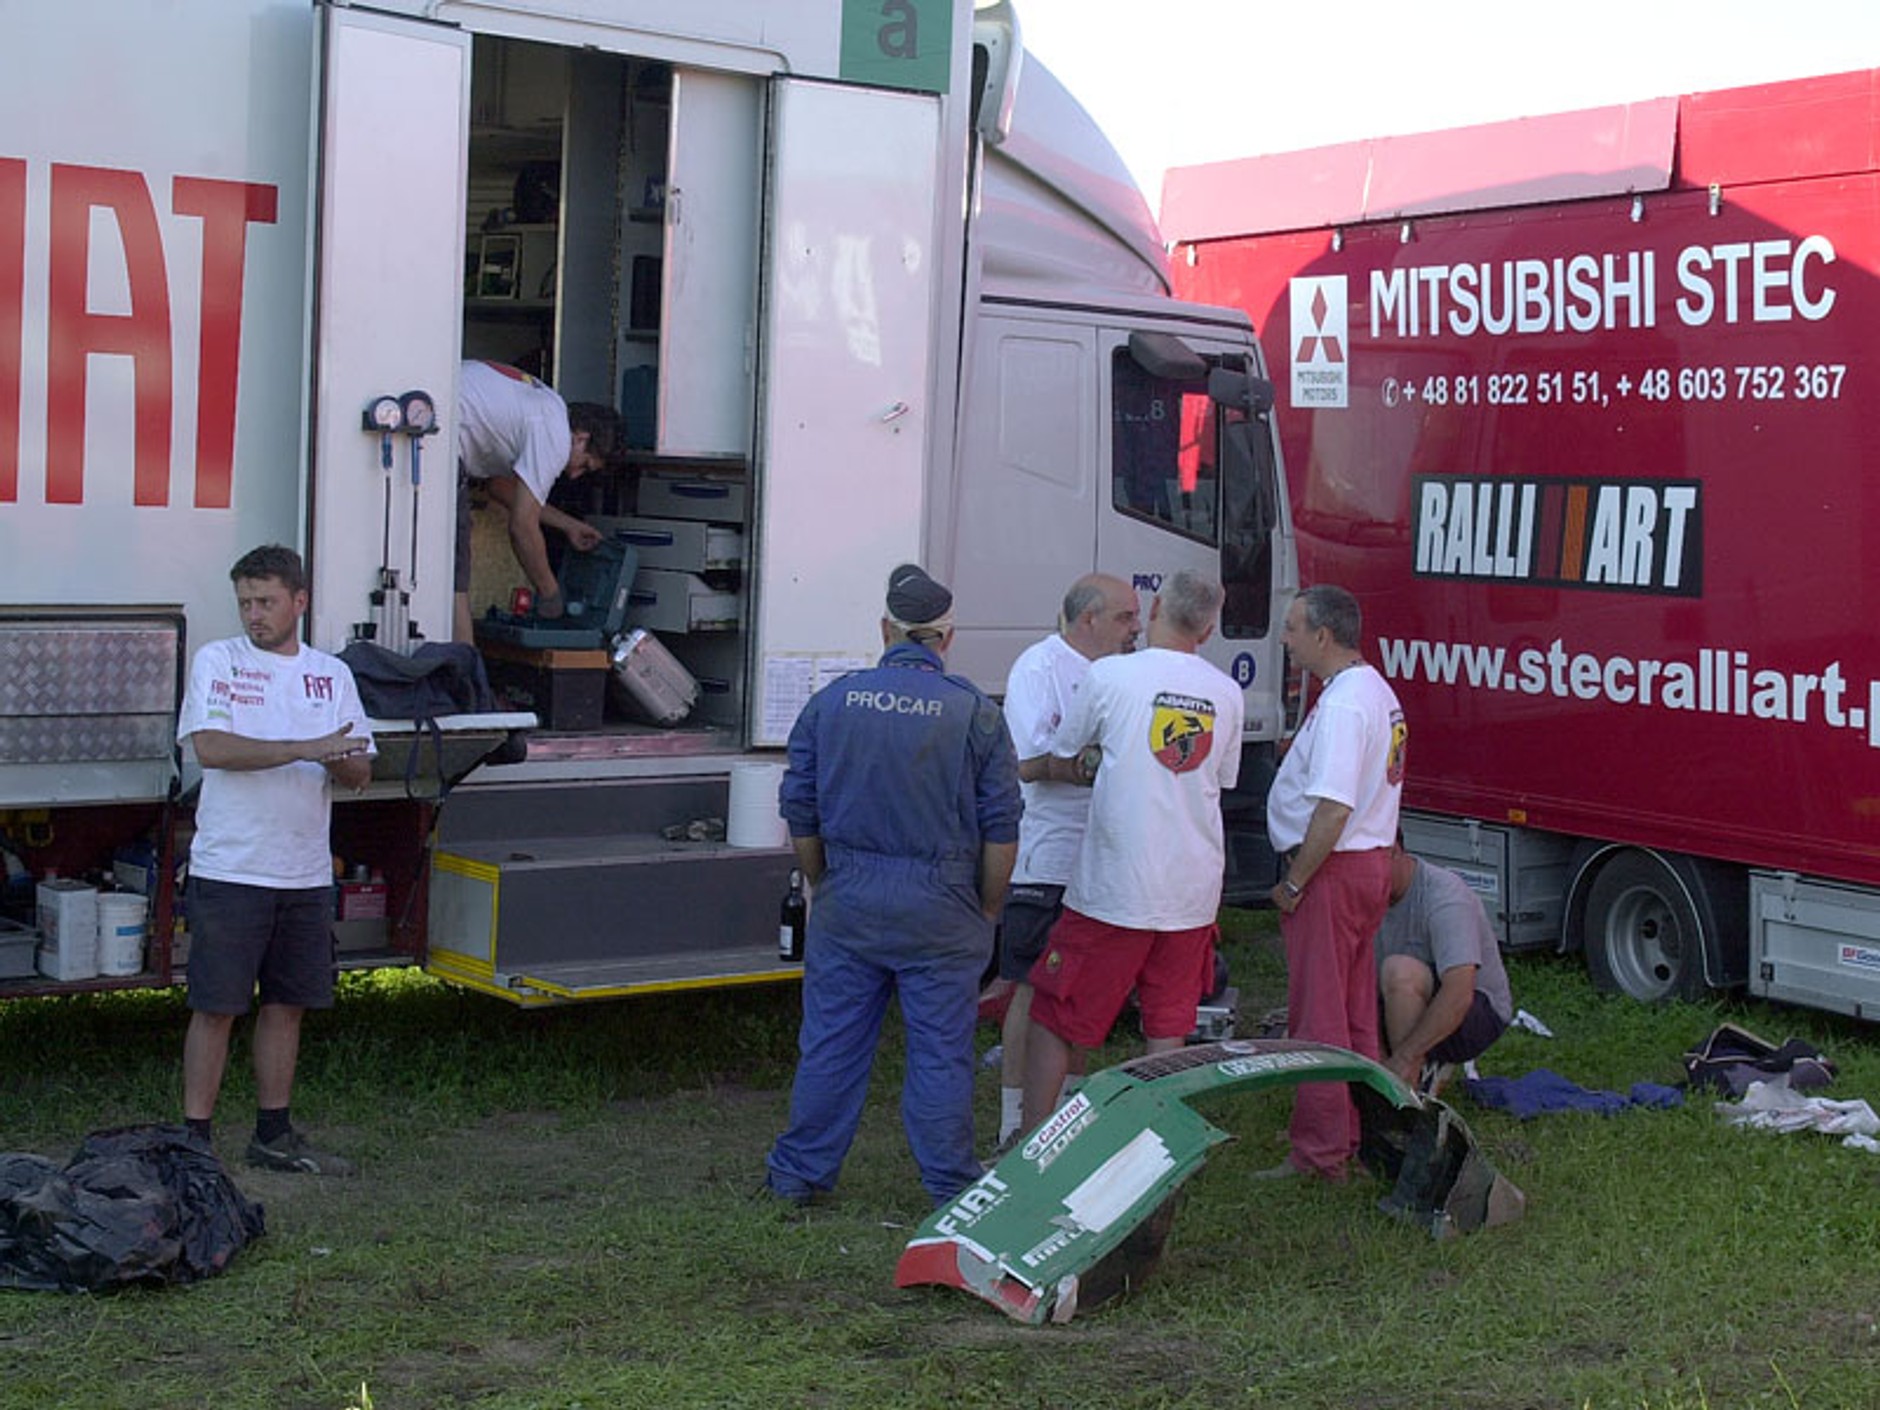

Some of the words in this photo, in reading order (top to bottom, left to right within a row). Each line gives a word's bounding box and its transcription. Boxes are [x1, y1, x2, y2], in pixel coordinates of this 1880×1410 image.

[877, 0, 919, 59] a
[1370, 250, 1657, 338] MITSUBISHI
[1675, 235, 1838, 326] STEC
[0, 157, 278, 509] IAT
[1421, 375, 1448, 405] 48
[1454, 374, 1478, 405] 81
[1486, 374, 1528, 404] 822
[1536, 372, 1563, 403] 51
[1571, 370, 1609, 408] 51,
[1639, 368, 1670, 401] 48
[1678, 367, 1727, 400] 603
[1734, 366, 1786, 399] 752
[1794, 364, 1847, 399] 367
[1415, 482, 1537, 577] RALLI
[1586, 486, 1697, 589] ART
[845, 689, 944, 717] PROCAR
[1038, 1097, 1085, 1145] Castrol
[934, 1168, 1008, 1236] FIAT
